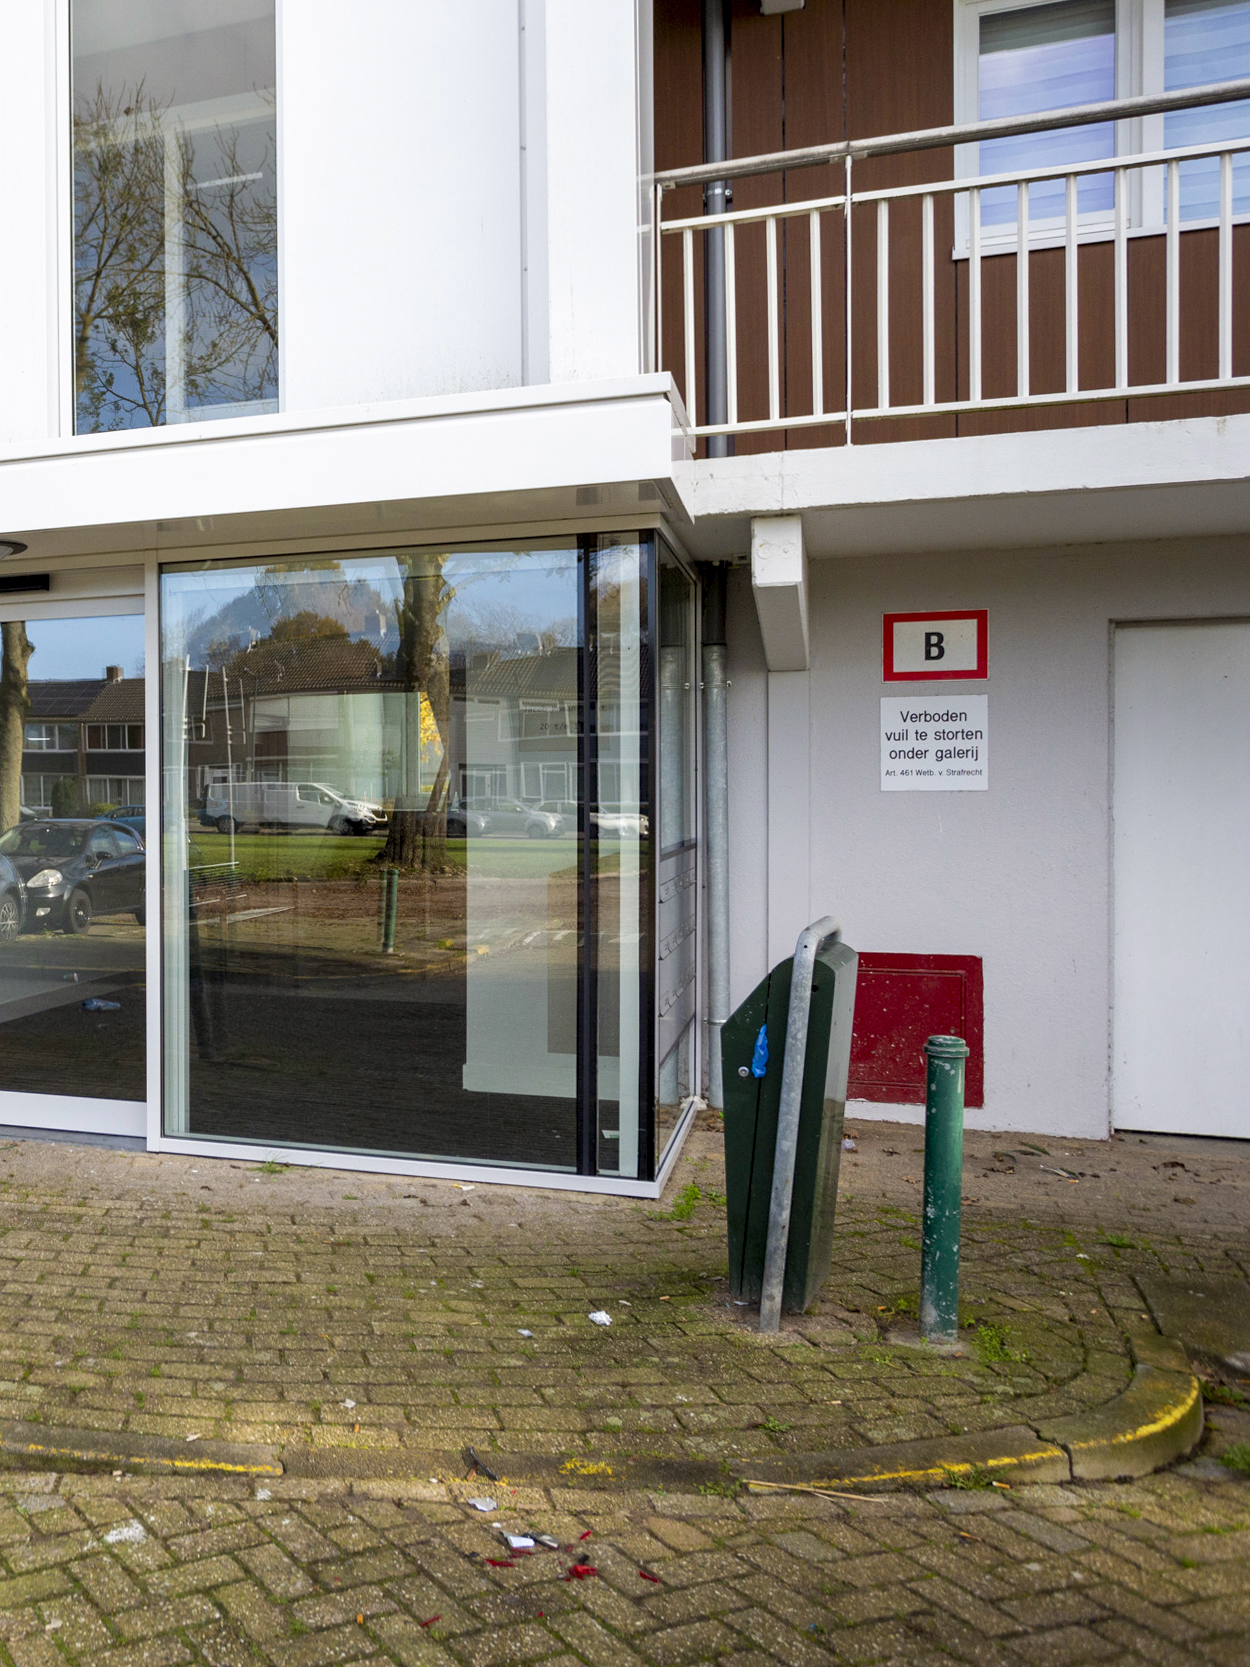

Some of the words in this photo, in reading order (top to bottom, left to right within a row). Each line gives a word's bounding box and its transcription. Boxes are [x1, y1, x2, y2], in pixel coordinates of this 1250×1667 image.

[924, 632, 945, 661] B
[900, 710, 967, 723] Verboden
[885, 729, 909, 741] vuil
[915, 729, 928, 741] te
[934, 728, 983, 741] storten
[889, 747, 929, 760] onder
[935, 746, 979, 762] galerij
[946, 768, 983, 776] Strafrecht
